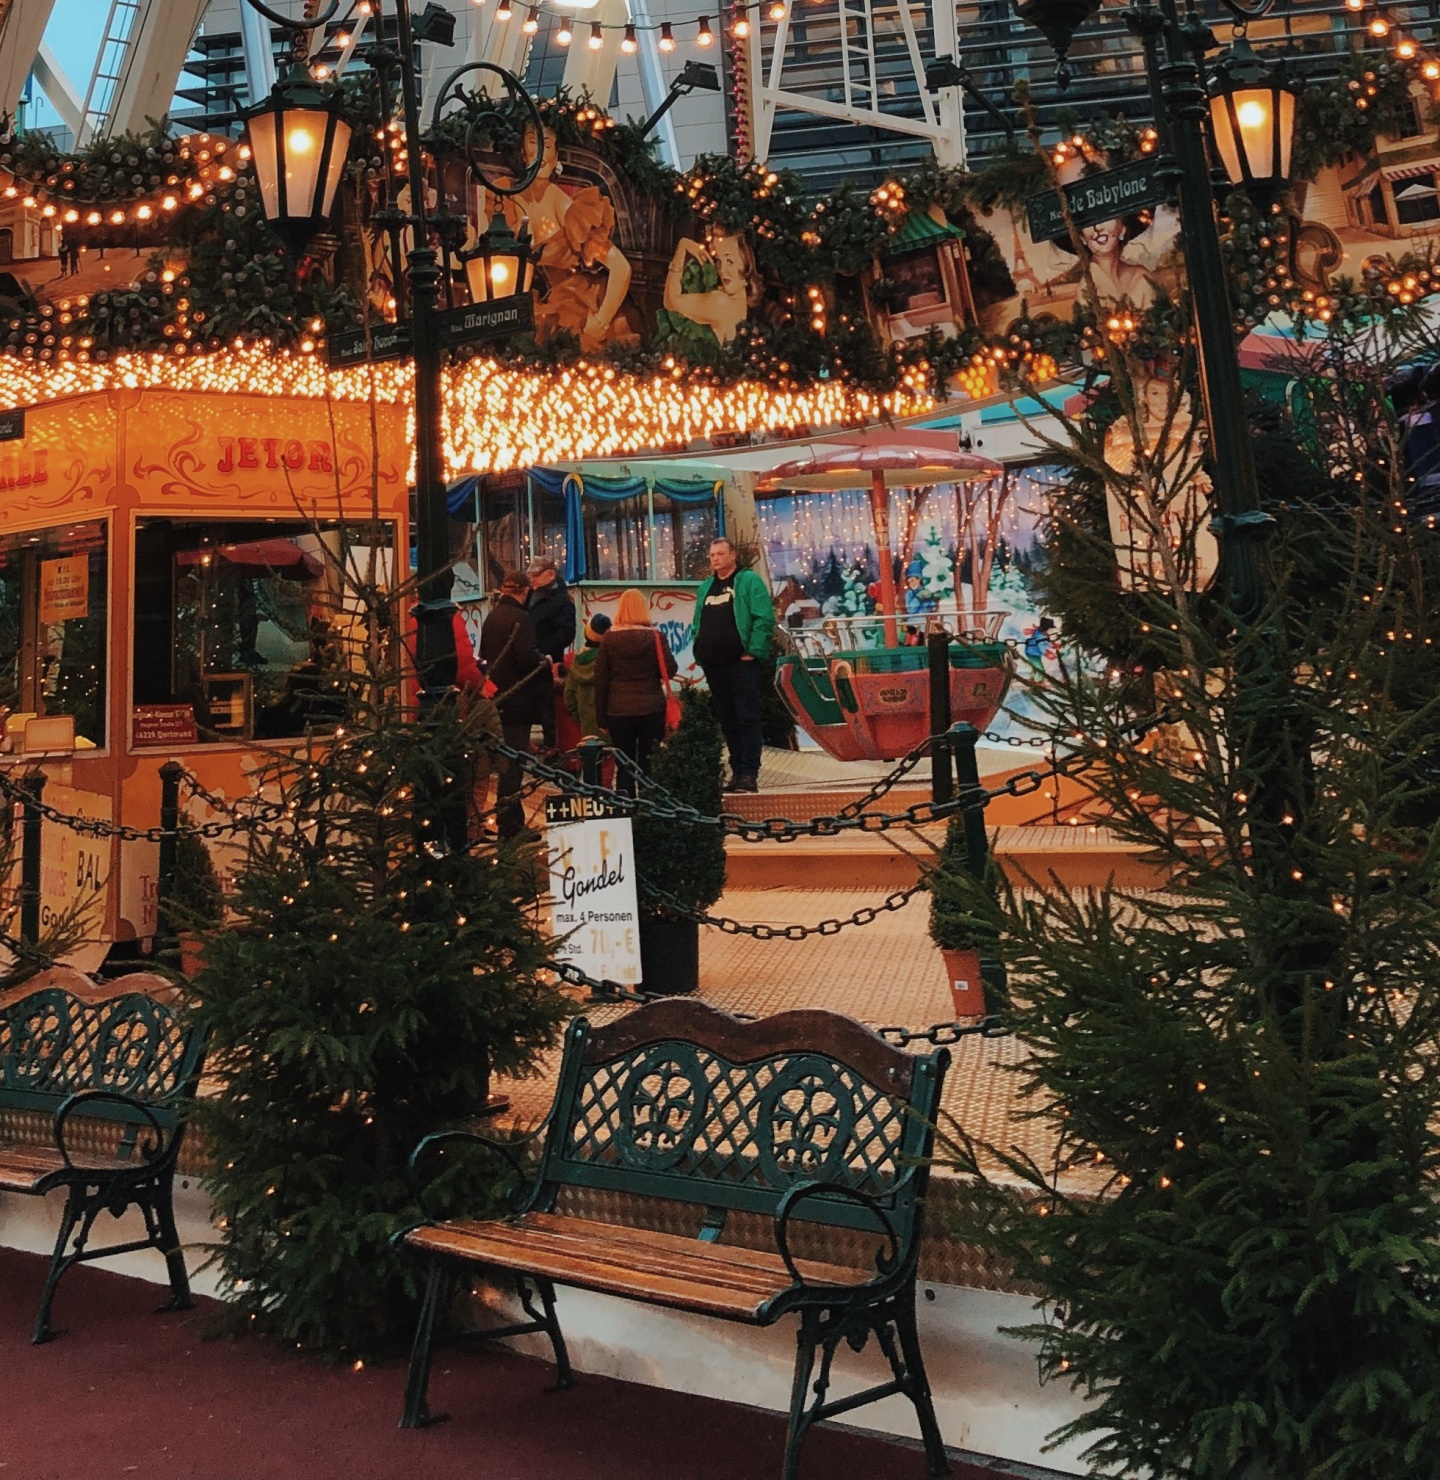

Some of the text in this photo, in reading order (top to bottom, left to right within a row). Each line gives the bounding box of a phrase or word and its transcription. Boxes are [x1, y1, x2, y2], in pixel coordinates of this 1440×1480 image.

[1086, 176, 1148, 209] Babylone
[464, 308, 518, 330] Marignan
[562, 853, 625, 910] Gondel
[556, 910, 633, 923] max. 4 Personen
